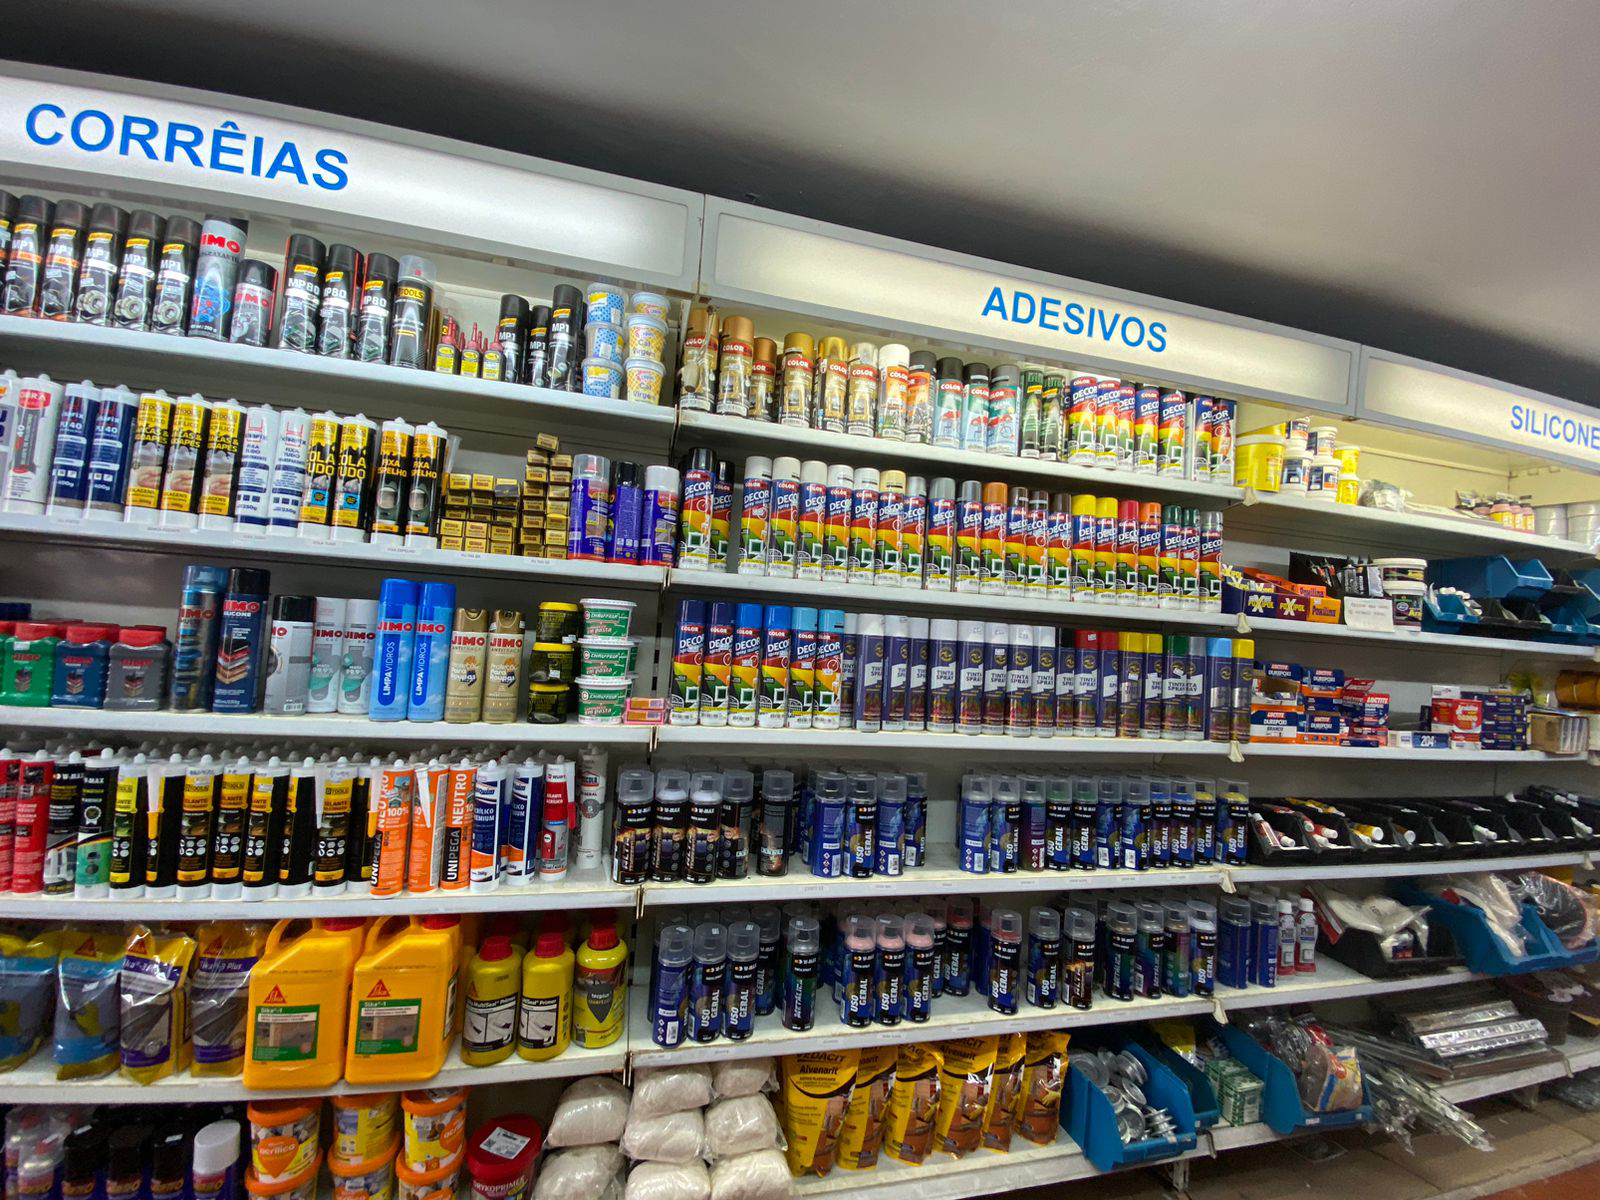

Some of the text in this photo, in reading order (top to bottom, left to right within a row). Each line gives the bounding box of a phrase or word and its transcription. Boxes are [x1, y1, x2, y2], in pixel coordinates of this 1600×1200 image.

[26, 103, 349, 191] CORRÊIAS
[287, 278, 320, 296] MP80
[552, 322, 570, 334] MP1
[981, 286, 1168, 353] ADESIVOS
[499, 331, 516, 341] MP1
[787, 359, 809, 368] COLOR
[852, 368, 874, 377] COLOR
[940, 383, 961, 391] COLOR
[1097, 390, 1120, 403] DECO
[1510, 405, 1600, 451] SILICONE
[310, 450, 336, 465] OLA
[340, 453, 367, 469] OLA
[307, 463, 335, 477] UDO
[339, 466, 366, 480] UDO
[685, 481, 712, 496] DECOR
[744, 490, 770, 504] DECOR
[713, 494, 733, 506] DECO
[805, 496, 826, 508] DECO
[963, 512, 982, 524] DECO
[1118, 529, 1139, 542] DECO
[1139, 531, 1160, 544] DECO
[1201, 538, 1223, 551] DECO
[377, 621, 413, 632] JIMO
[710, 626, 727, 634] COLOR
[344, 631, 376, 640] JIMO
[450, 635, 486, 646] JIMO
[490, 637, 523, 648] JIMO
[797, 643, 817, 656] DECO
[817, 641, 841, 655] ECOR
[383, 641, 396, 696] LIMPAVIDROS
[415, 642, 427, 696] LIMPAVIDROS
[1420, 735, 1435, 748] 204
[452, 773, 467, 825] NEUTRO
[387, 807, 409, 817] 100%
[864, 829, 873, 857] GERAL
[1055, 827, 1064, 852] GERAL
[1081, 827, 1089, 852] GERAL
[1161, 826, 1169, 850] GERAL
[1179, 826, 1189, 850] GERAL
[1197, 837, 1205, 853] USO
[1204, 825, 1213, 848] GERAL
[1237, 825, 1245, 848] GERAL
[447, 829, 461, 880] UNIPEGA
[1047, 840, 1055, 857] USO
[1171, 838, 1179, 854] USO
[1228, 838, 1237, 854] USO
[856, 846, 865, 864] USO
[933, 954, 941, 979] GERAL
[950, 952, 960, 977] GERAL
[1206, 955, 1214, 979] GERAL
[756, 968, 765, 995] GERAL
[921, 974, 930, 1001] GERAL
[999, 968, 1008, 995] GERAL
[1041, 979, 1050, 996] USO
[859, 978, 868, 1006] GERAL
[890, 977, 899, 1005] GERAL
[710, 989, 720, 1019] GERAL
[740, 989, 749, 1018] GERAL
[850, 994, 859, 1013] USO
[881, 992, 890, 1011] USO
[913, 991, 922, 1009] USO
[701, 1008, 710, 1027] USO
[730, 1006, 739, 1025] USO
[799, 1064, 839, 1075] Alvenarit
